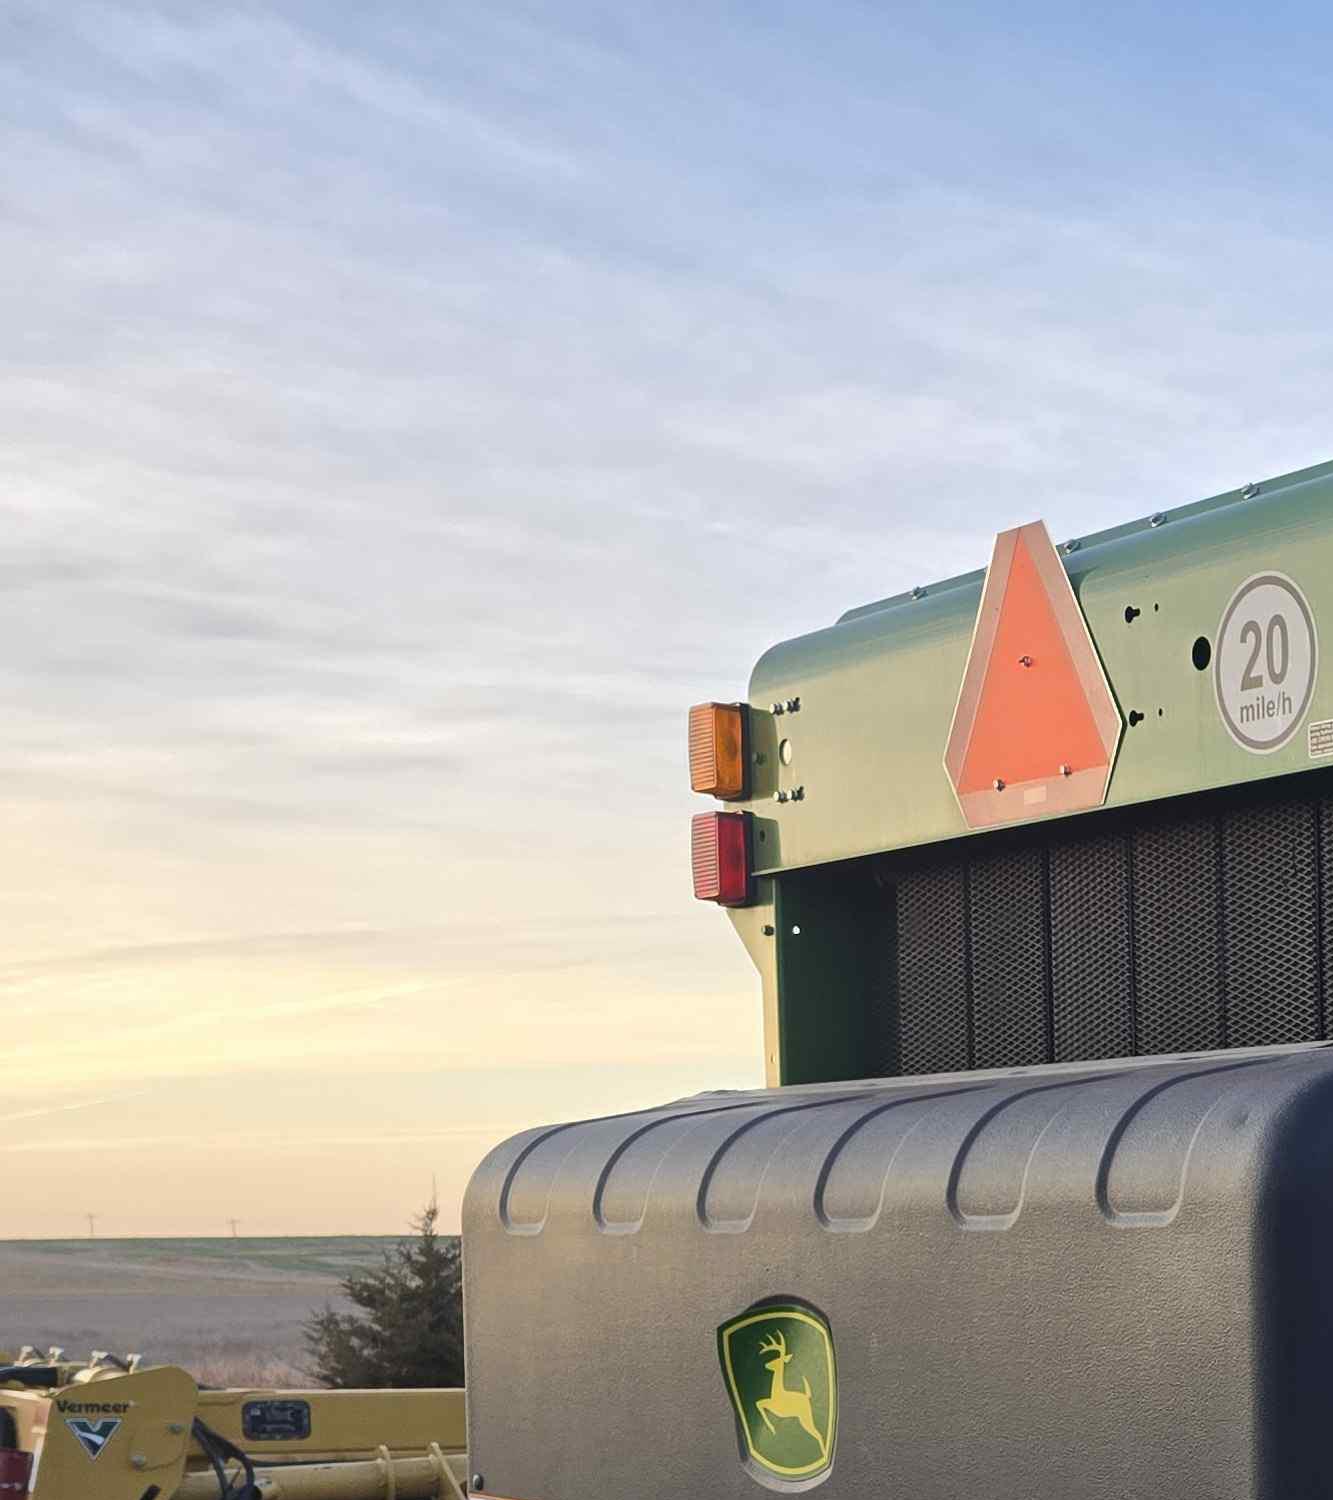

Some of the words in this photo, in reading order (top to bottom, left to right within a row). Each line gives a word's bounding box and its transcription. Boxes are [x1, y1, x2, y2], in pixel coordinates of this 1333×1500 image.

[1239, 613, 1289, 692] 20
[1239, 691, 1293, 723] mile/h
[56, 1400, 129, 1413] Vermeer
